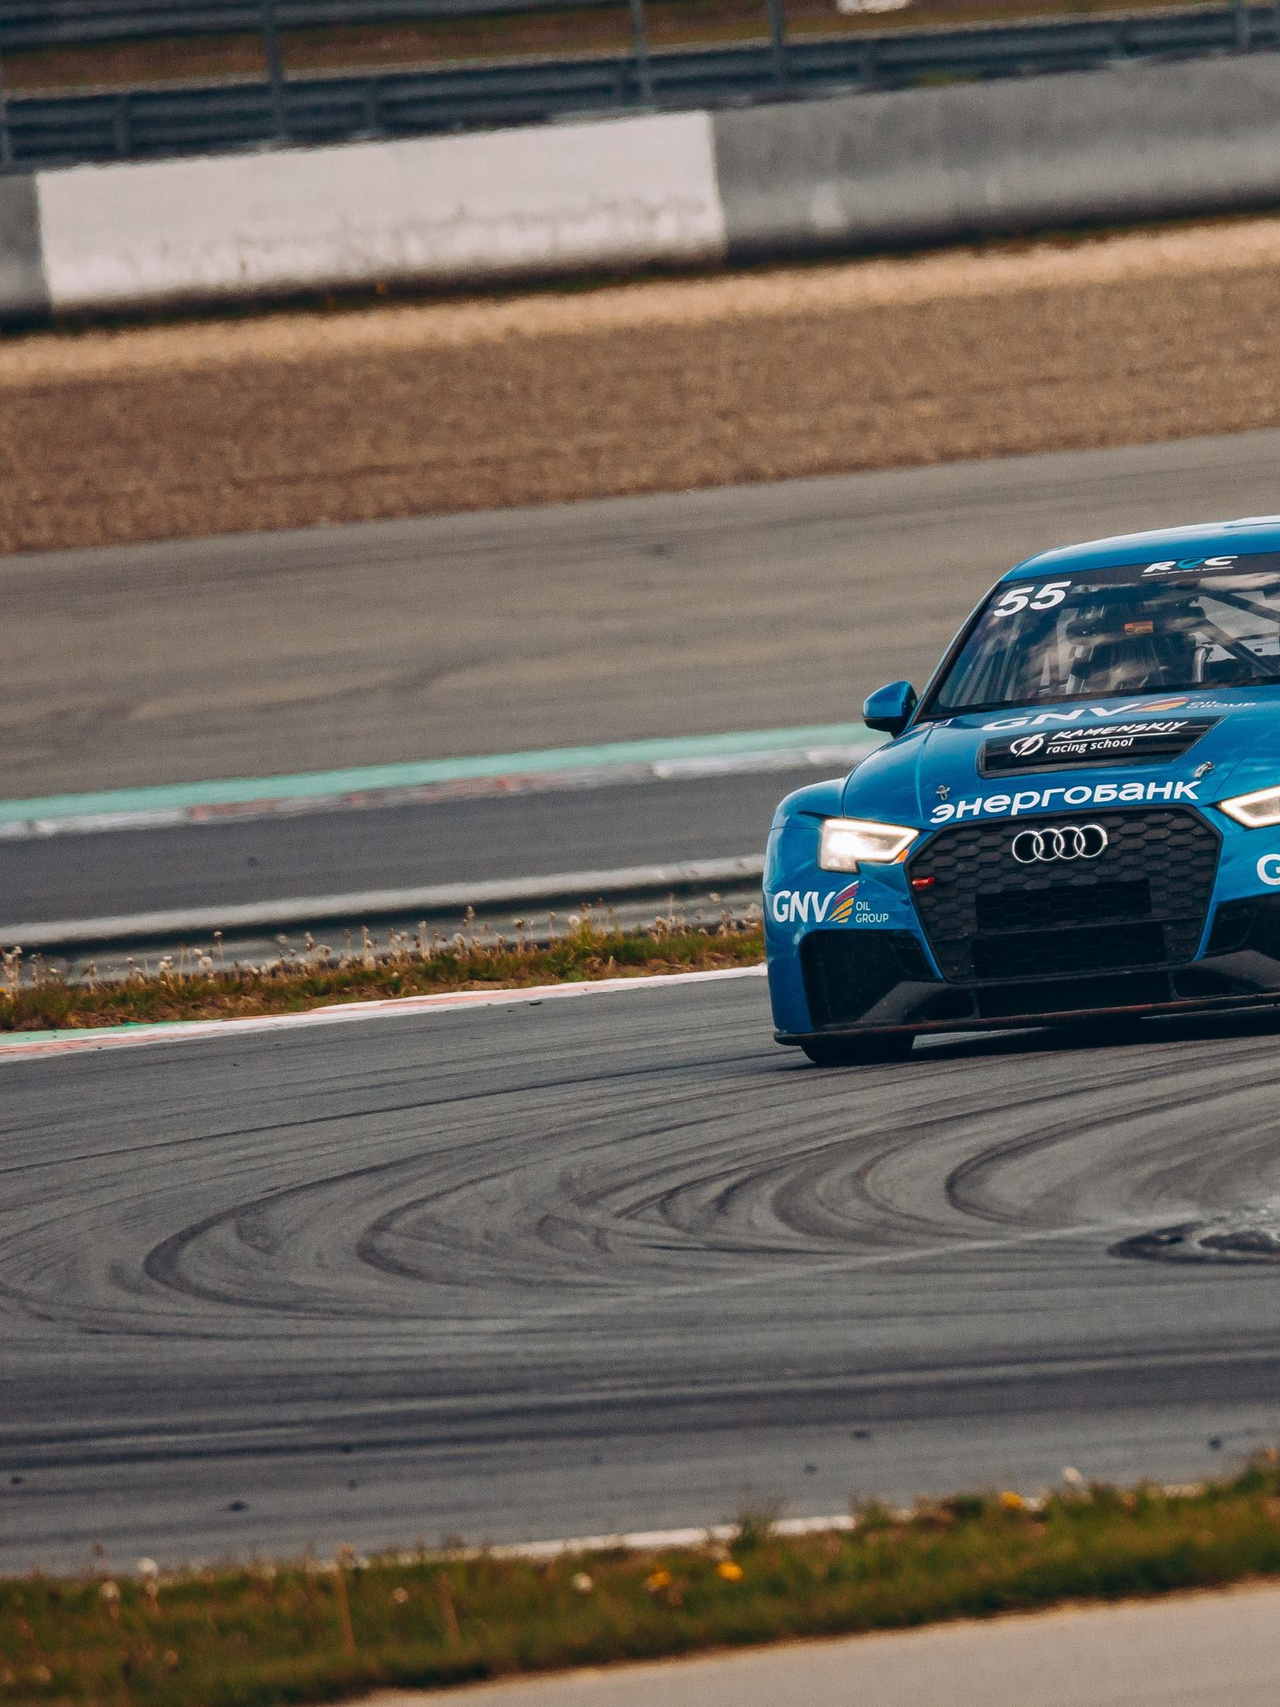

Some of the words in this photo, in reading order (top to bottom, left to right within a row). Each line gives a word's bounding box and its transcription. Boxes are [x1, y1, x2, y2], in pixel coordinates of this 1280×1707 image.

[993, 580, 1072, 617] 55
[980, 703, 1142, 731] GNV
[1052, 720, 1188, 740] KAMENSKIY
[1046, 741, 1087, 755] racing
[1090, 737, 1134, 751] school
[773, 890, 836, 923] GNV
[855, 901, 871, 911] OIL
[855, 913, 889, 923] GROUP
